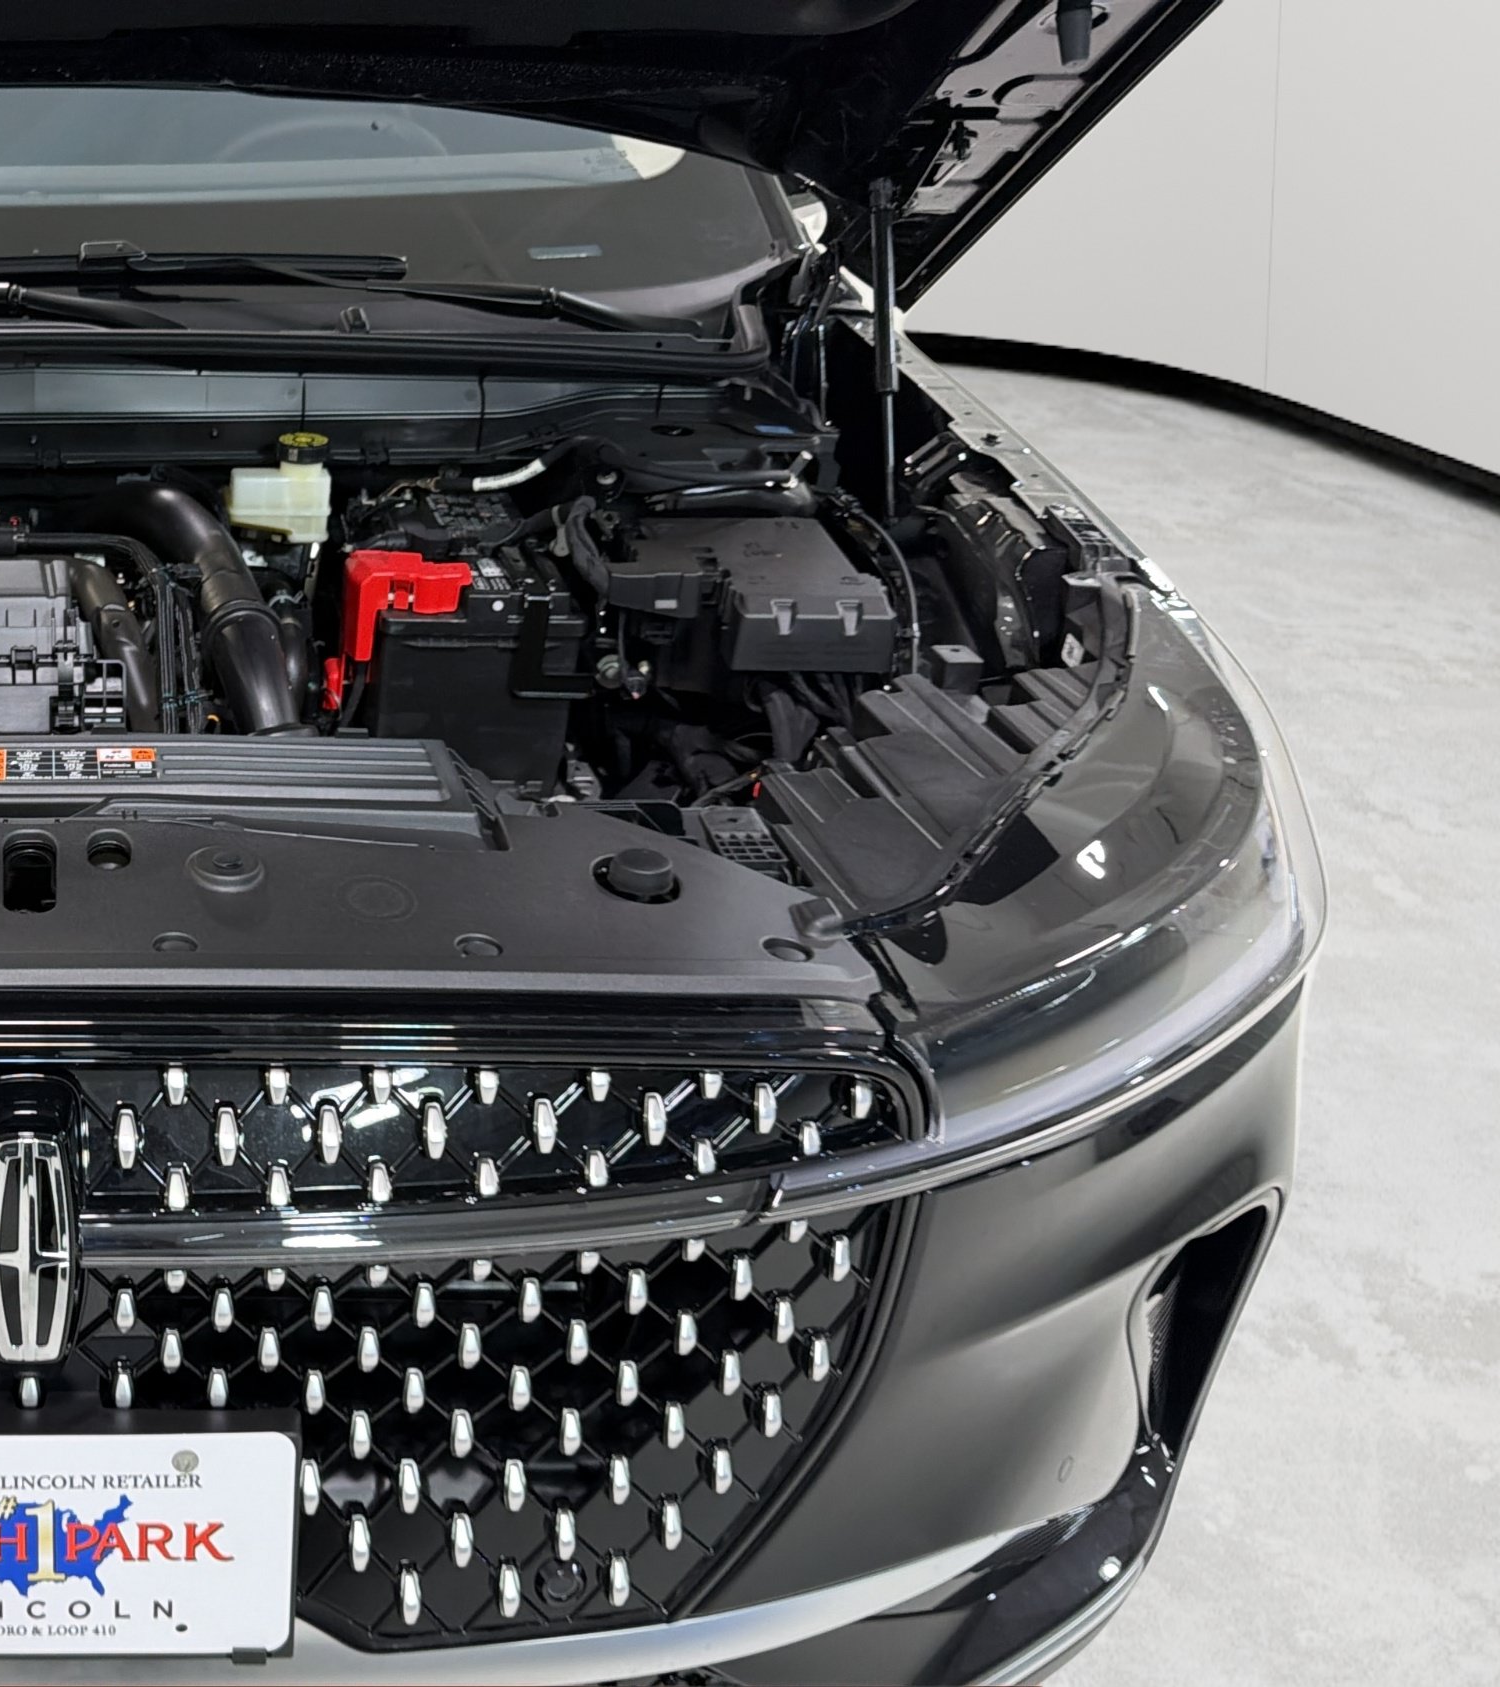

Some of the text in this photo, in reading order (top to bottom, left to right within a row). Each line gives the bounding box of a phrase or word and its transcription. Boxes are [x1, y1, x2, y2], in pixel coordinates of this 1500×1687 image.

[0, 1474, 96, 1490] LINCOLN
[102, 1473, 203, 1490] RETAILER
[65, 1522, 235, 1563] PARK
[31, 1625, 43, 1637] &
[49, 1625, 88, 1637] LOOP
[92, 1624, 116, 1637] 410
